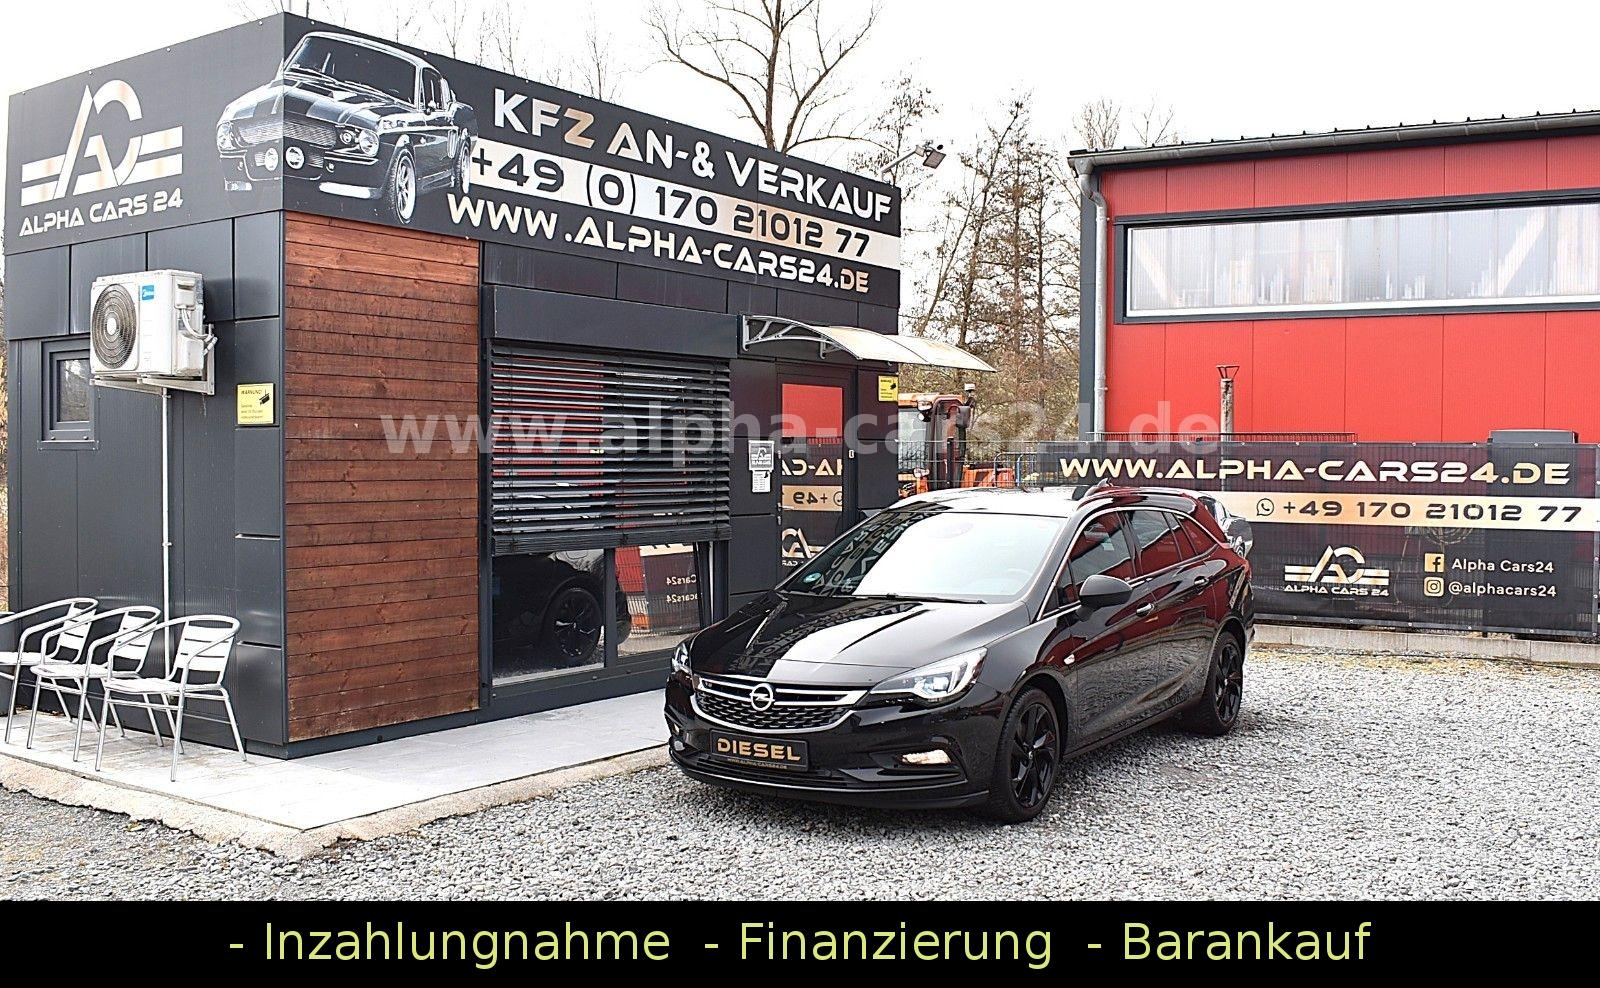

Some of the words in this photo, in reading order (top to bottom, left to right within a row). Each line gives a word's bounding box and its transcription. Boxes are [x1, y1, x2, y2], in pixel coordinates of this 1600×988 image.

[494, 88, 596, 149] KFZ
[725, 151, 892, 222] VERKAUF
[19, 207, 85, 237] ALPHA
[89, 194, 148, 223] CARS
[153, 188, 184, 213] 24
[472, 148, 565, 193] +49
[586, 164, 636, 215] (0)
[655, 186, 718, 226] 170
[733, 204, 823, 249] 21012
[835, 227, 870, 257] 77
[1060, 458, 1571, 486] WWW.ALPHA-CARS24.DE
[1283, 500, 1343, 518] +49
[1356, 501, 1411, 519] 170
[1426, 503, 1522, 522] 21012
[1538, 505, 1582, 523] 77
[1452, 559, 1496, 573] Alpha
[1500, 560, 1554, 573] Cars24
[1284, 584, 1328, 594] ALPHA
[1331, 586, 1368, 596] CARS
[1371, 588, 1390, 597] 24
[1448, 581, 1557, 597] @alphacars24
[717, 738, 801, 761] DIESEL
